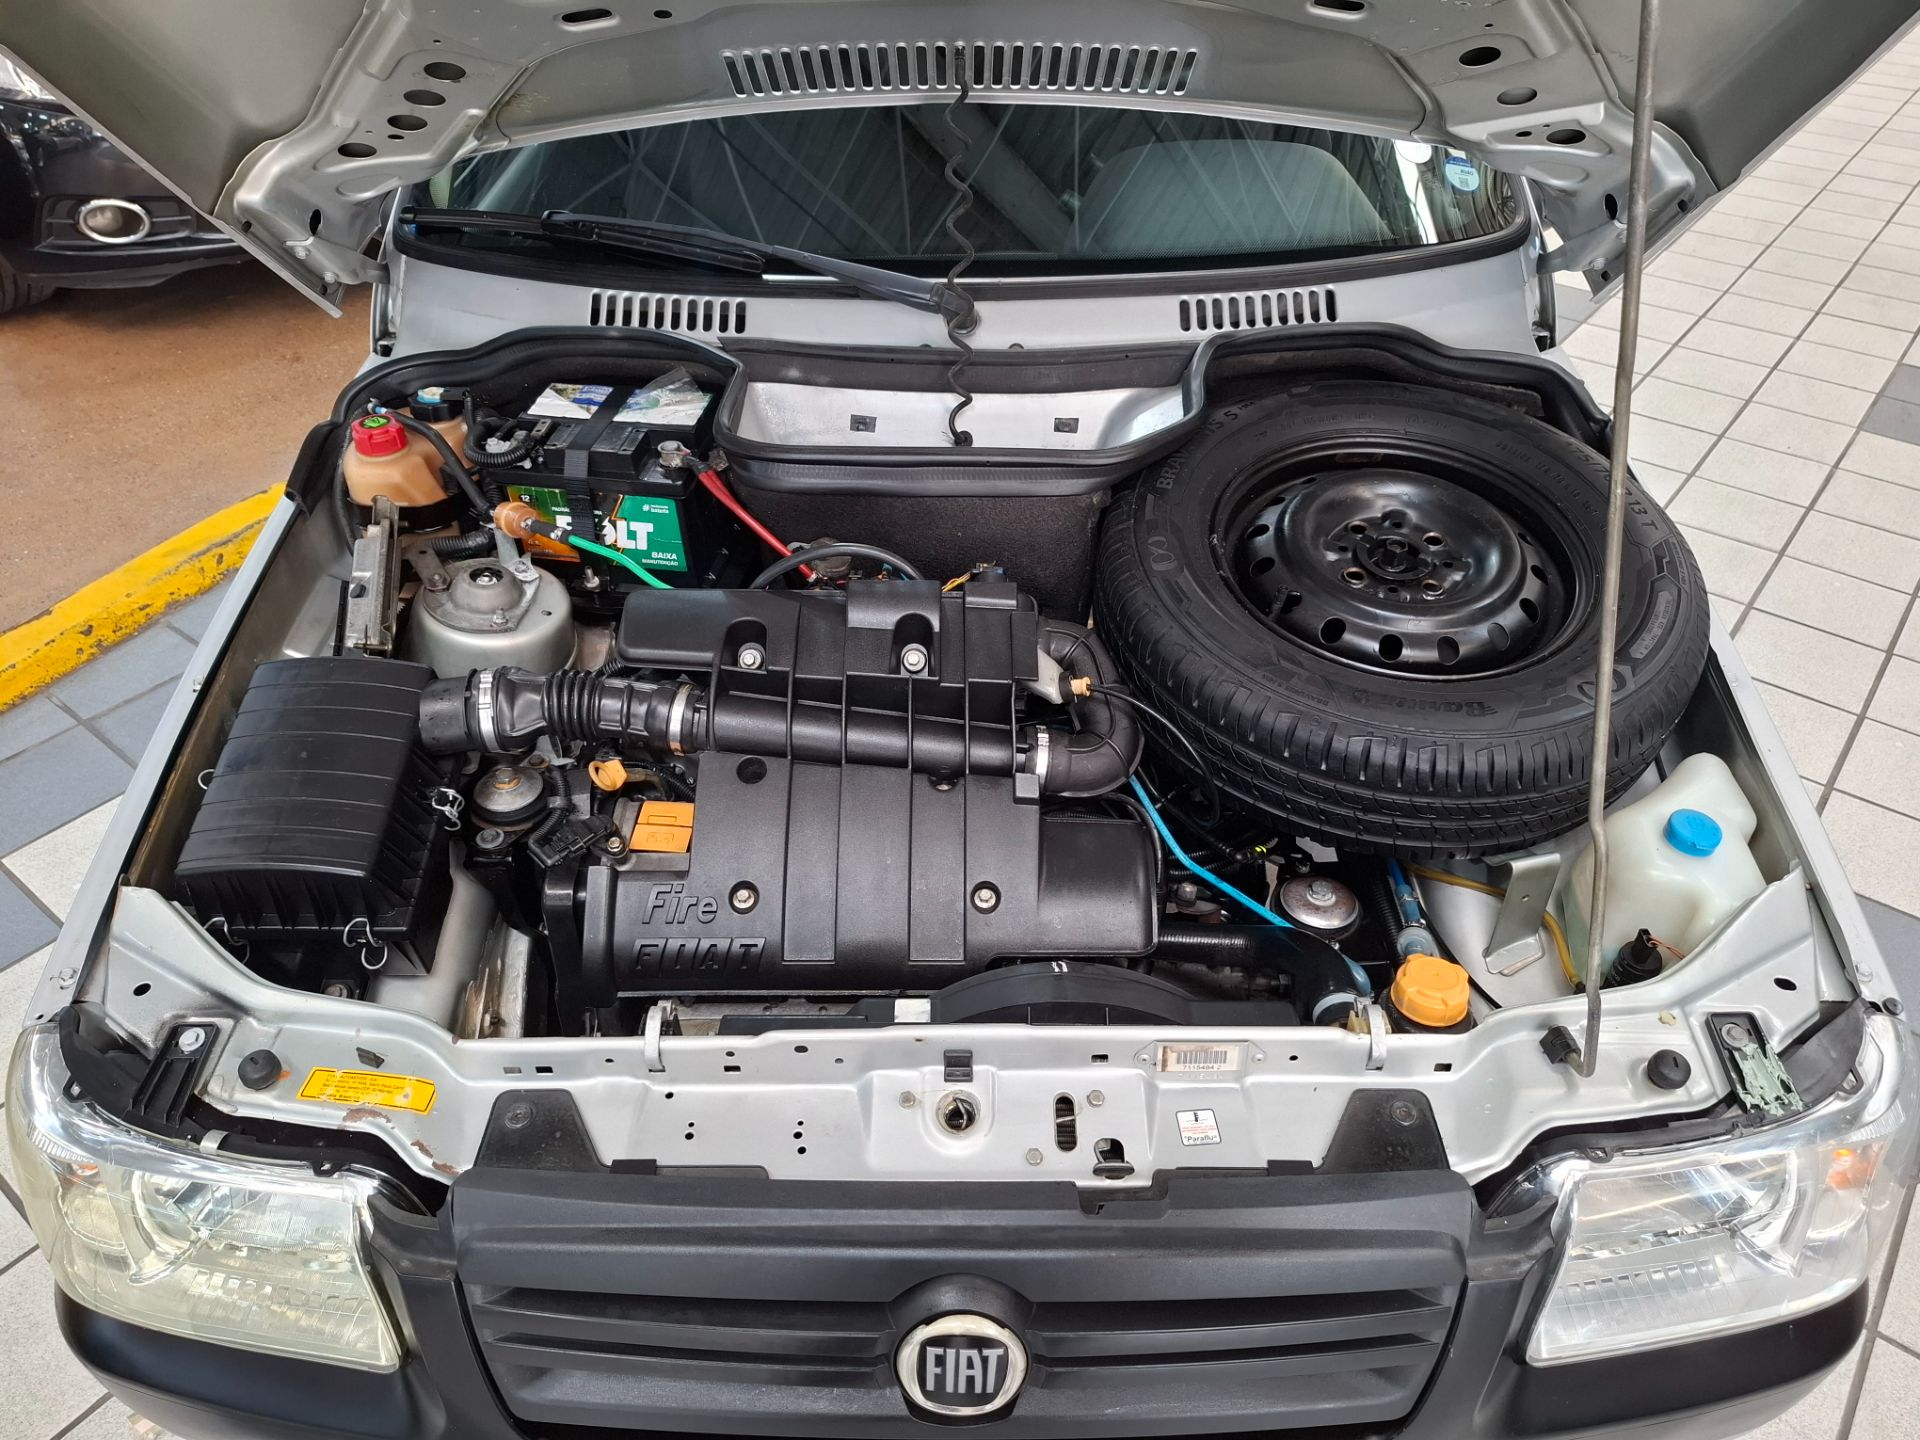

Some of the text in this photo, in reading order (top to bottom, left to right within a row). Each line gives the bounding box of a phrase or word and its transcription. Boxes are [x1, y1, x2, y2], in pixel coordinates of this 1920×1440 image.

[642, 558, 679, 567] MANUTENÇÃO
[651, 551, 678, 560] BAIXA
[642, 883, 719, 924] Fire
[632, 937, 766, 976] FIAT
[926, 1346, 1004, 1394] FIAT
